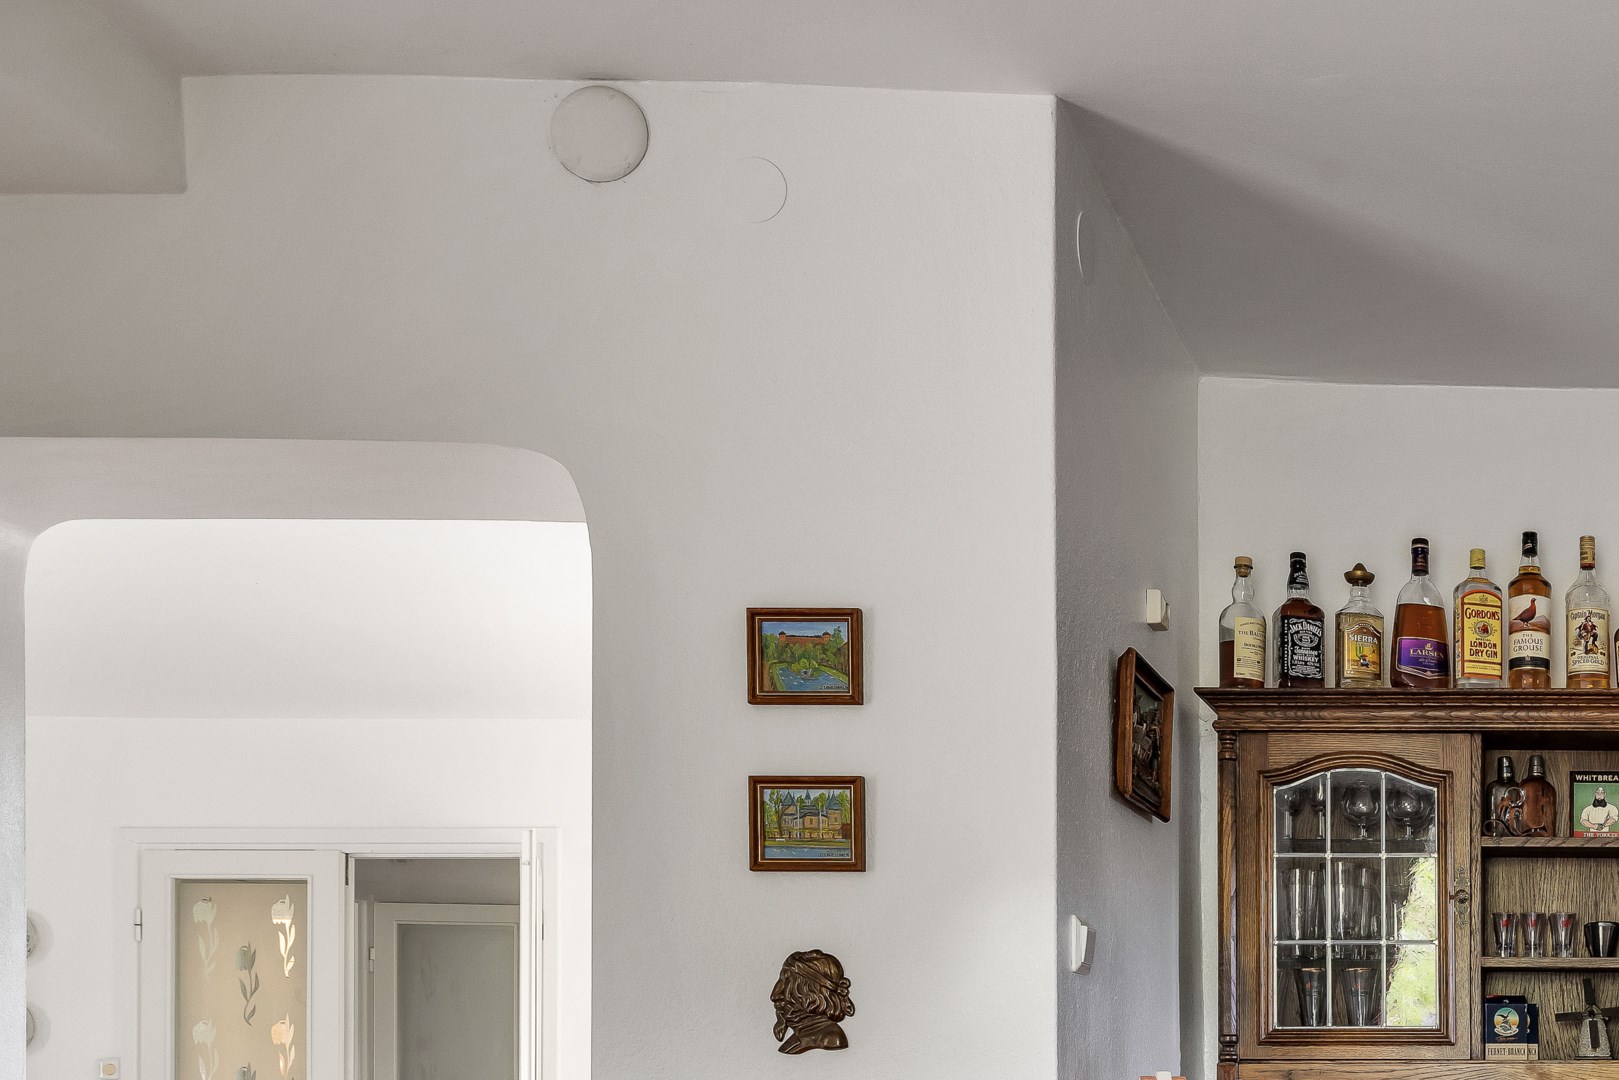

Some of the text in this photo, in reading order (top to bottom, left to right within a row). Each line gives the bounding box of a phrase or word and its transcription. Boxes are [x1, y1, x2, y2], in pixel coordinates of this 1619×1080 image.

[1464, 607, 1500, 621] GORDON'S
[1570, 609, 1605, 621] Captain Morgan
[1289, 623, 1303, 633] JACK
[1349, 634, 1378, 644] SIERRA
[1513, 637, 1544, 646] FAMOUS
[1470, 640, 1497, 649] LONDON
[1513, 644, 1543, 653] GROUSE
[1409, 648, 1444, 659] LARSEN
[1469, 648, 1498, 659] DRY GIN
